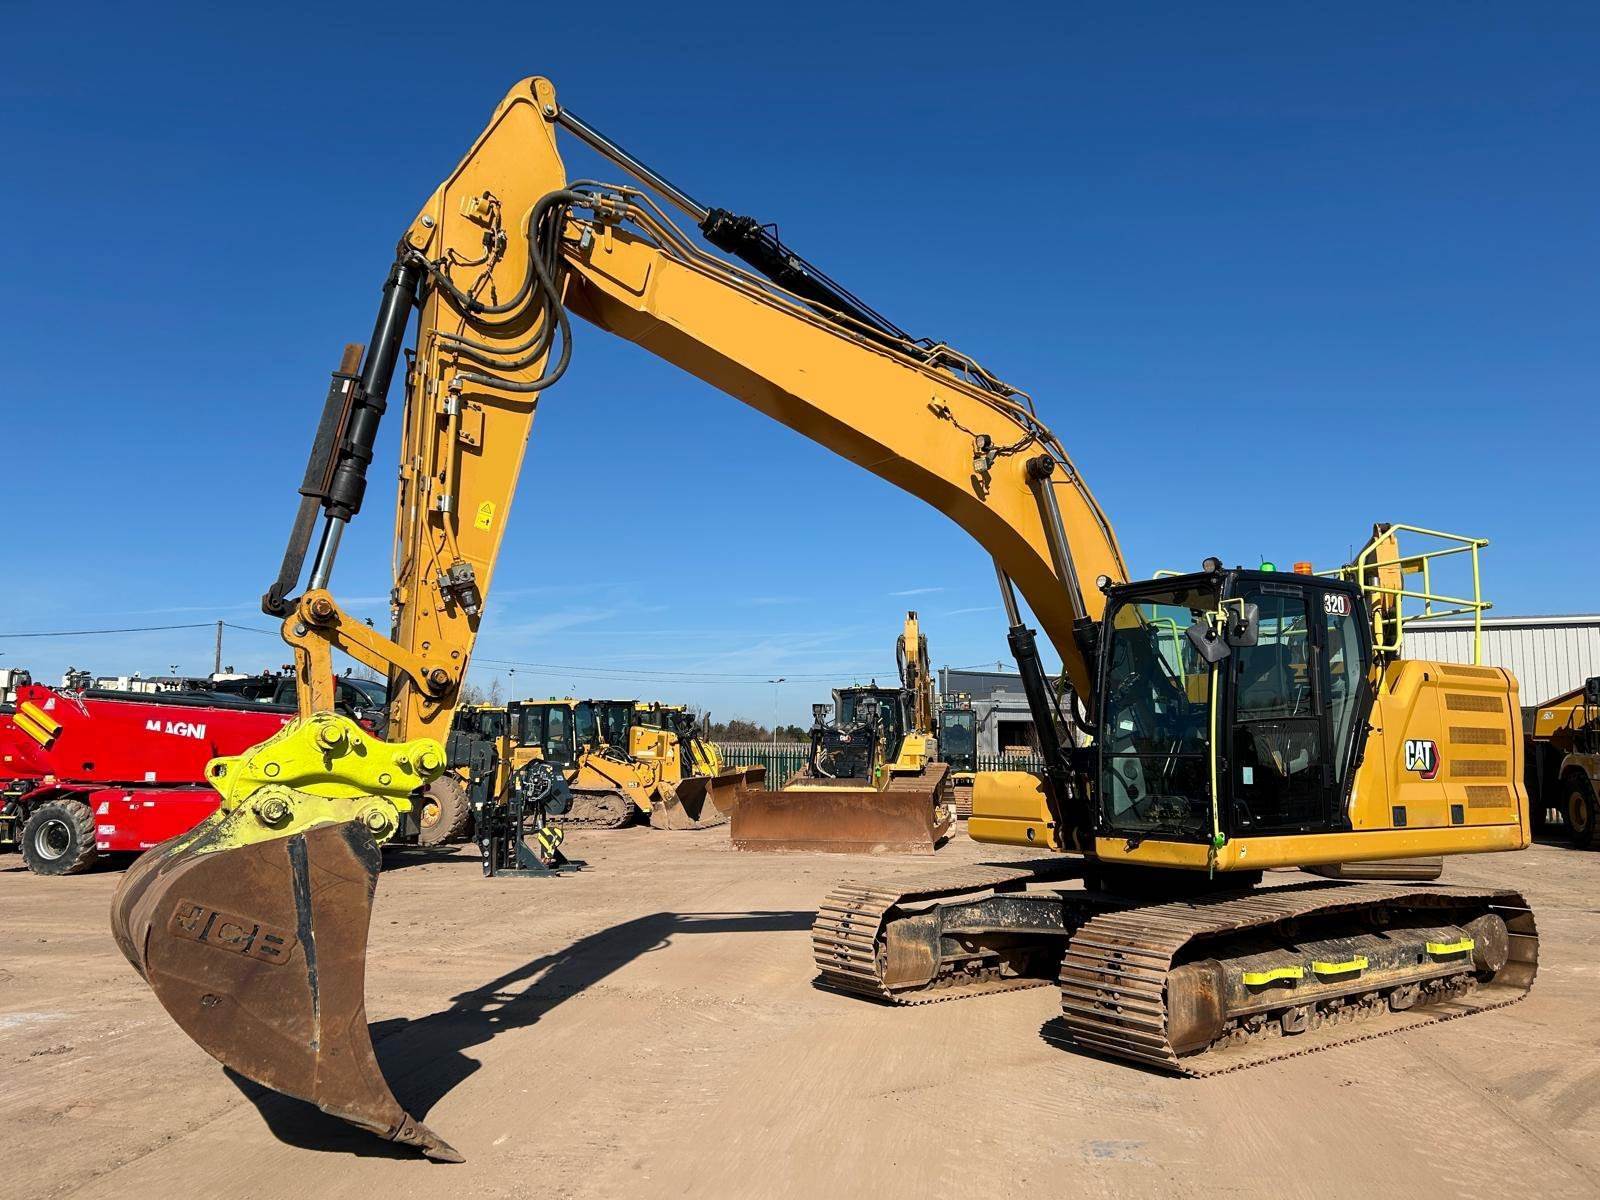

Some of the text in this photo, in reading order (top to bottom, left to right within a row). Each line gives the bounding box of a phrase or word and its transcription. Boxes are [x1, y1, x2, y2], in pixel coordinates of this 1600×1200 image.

[1324, 594, 1345, 614] 320
[145, 719, 206, 740] MAGNI
[1405, 740, 1432, 771] CAT
